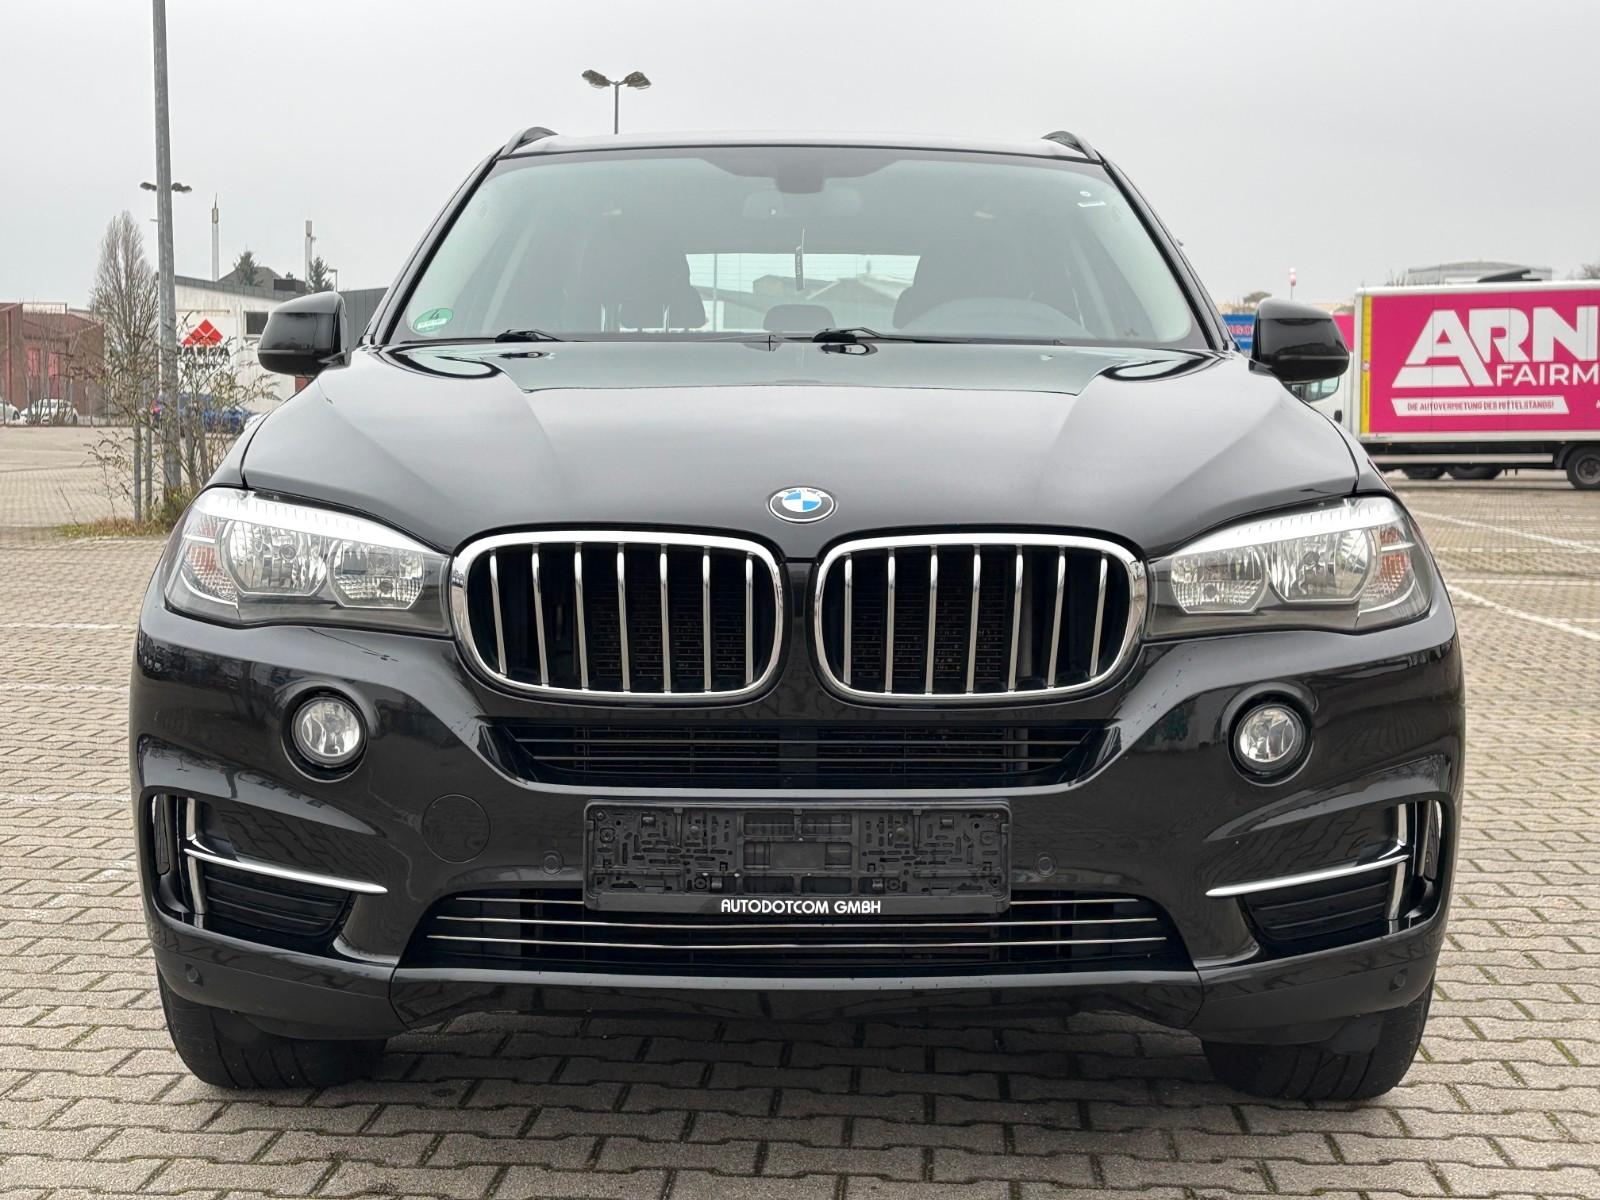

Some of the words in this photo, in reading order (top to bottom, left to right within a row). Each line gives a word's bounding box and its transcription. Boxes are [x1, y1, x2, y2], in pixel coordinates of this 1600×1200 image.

[1391, 306, 1598, 388] ARN
[1496, 362, 1600, 387] FAIRM
[1407, 401, 1418, 411] DIE
[1420, 400, 1482, 411] AUTOVERMIETUNG
[1484, 400, 1497, 410] DES
[720, 898, 829, 914] AUTODOTCOM
[833, 900, 881, 914] GMBH
